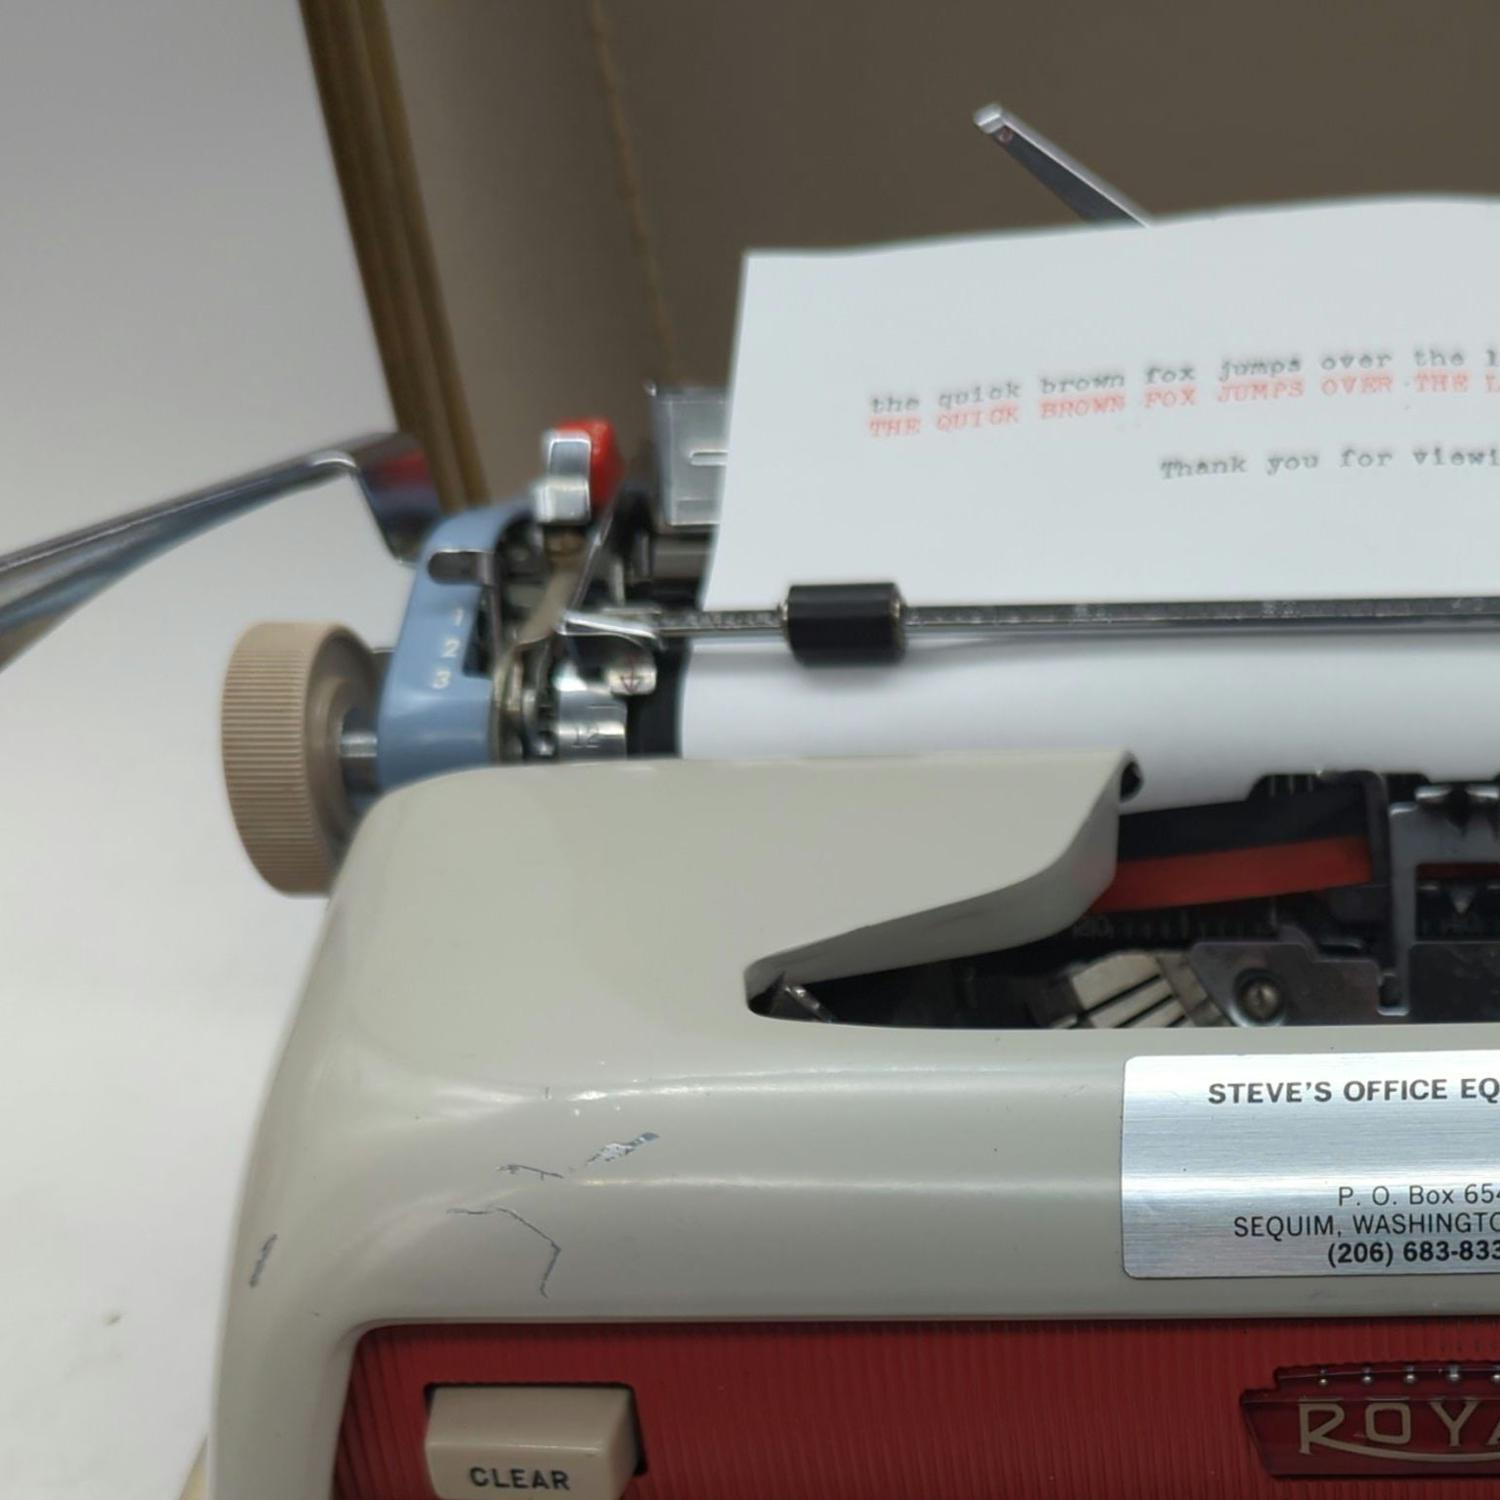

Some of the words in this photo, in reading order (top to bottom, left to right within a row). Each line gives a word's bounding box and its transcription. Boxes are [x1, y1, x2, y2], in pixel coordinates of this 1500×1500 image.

[870, 395, 921, 415] the
[938, 381, 1021, 409] quick
[1039, 373, 1126, 395] brown
[1144, 364, 1196, 385] fox
[1218, 356, 1303, 382] jumps
[1319, 352, 1392, 371] over
[1413, 349, 1466, 368] the
[868, 416, 922, 438] THE
[936, 404, 1020, 433] QUICK
[1039, 394, 1126, 420] BROWN
[1143, 386, 1197, 409] FOX
[1217, 378, 1304, 403] JUMPS
[1320, 374, 1394, 396] OVER
[1414, 371, 1469, 393] THE
[1160, 455, 1248, 480] Thank
[1265, 453, 1320, 476] you
[1339, 448, 1394, 468] for
[443, 637, 461, 658] 2
[432, 669, 451, 690] 3
[1207, 1081, 1333, 1105] STEVE'S
[1343, 1078, 1448, 1103] OFFICE
[1337, 1186, 1362, 1206] P.
[1371, 1186, 1398, 1205] O.
[1408, 1185, 1455, 1205] Box
[1233, 1214, 1342, 1239] SEQUIM,
[1327, 1241, 1394, 1269] (206)
[469, 1466, 570, 1491] CLEAR
